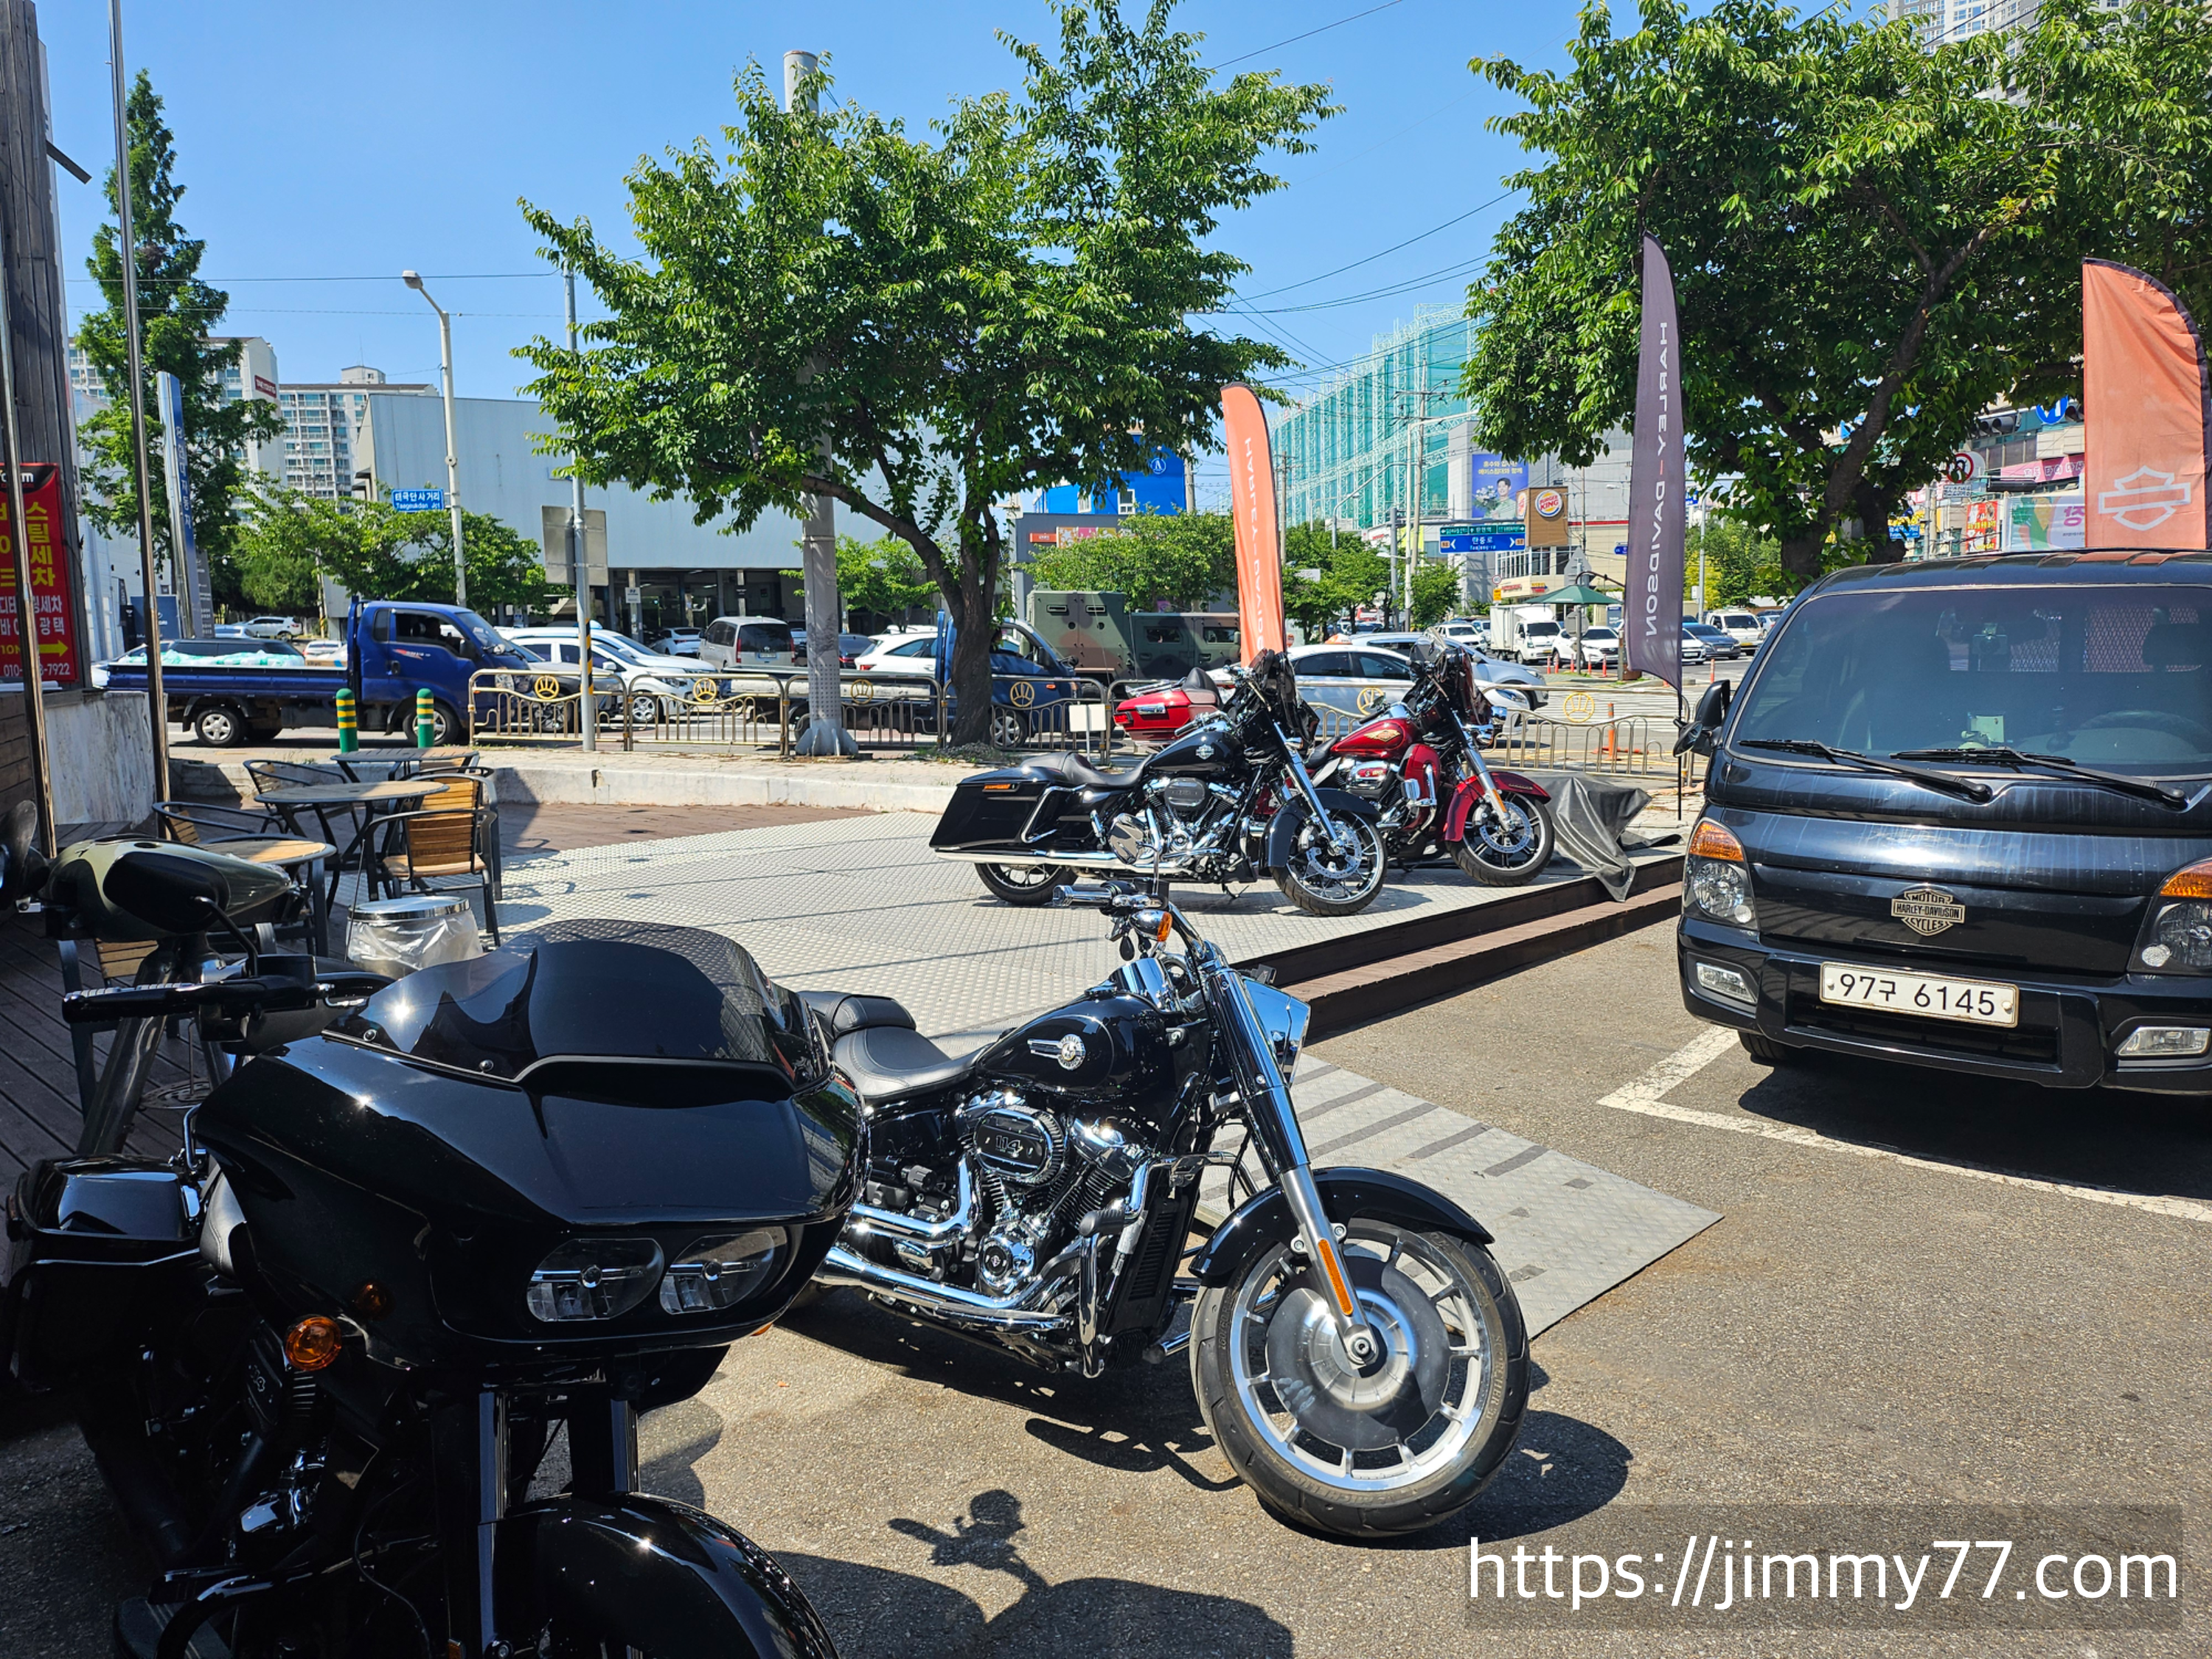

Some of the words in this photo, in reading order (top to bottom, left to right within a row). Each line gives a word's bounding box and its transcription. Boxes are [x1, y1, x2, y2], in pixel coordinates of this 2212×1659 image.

[394, 491, 440, 502] 태극단사거리
[1539, 495, 1558, 504] BURGER
[1540, 501, 1559, 510] KING
[26, 501, 56, 587] 스팀세차
[1911, 892, 1946, 905] MOTOR
[1896, 903, 1960, 919] HARLEY-DAVIDSON
[1910, 919, 1945, 932] CYCLES
[1840, 973, 1896, 1002] 97구
[1913, 984, 1995, 1016] 6145
